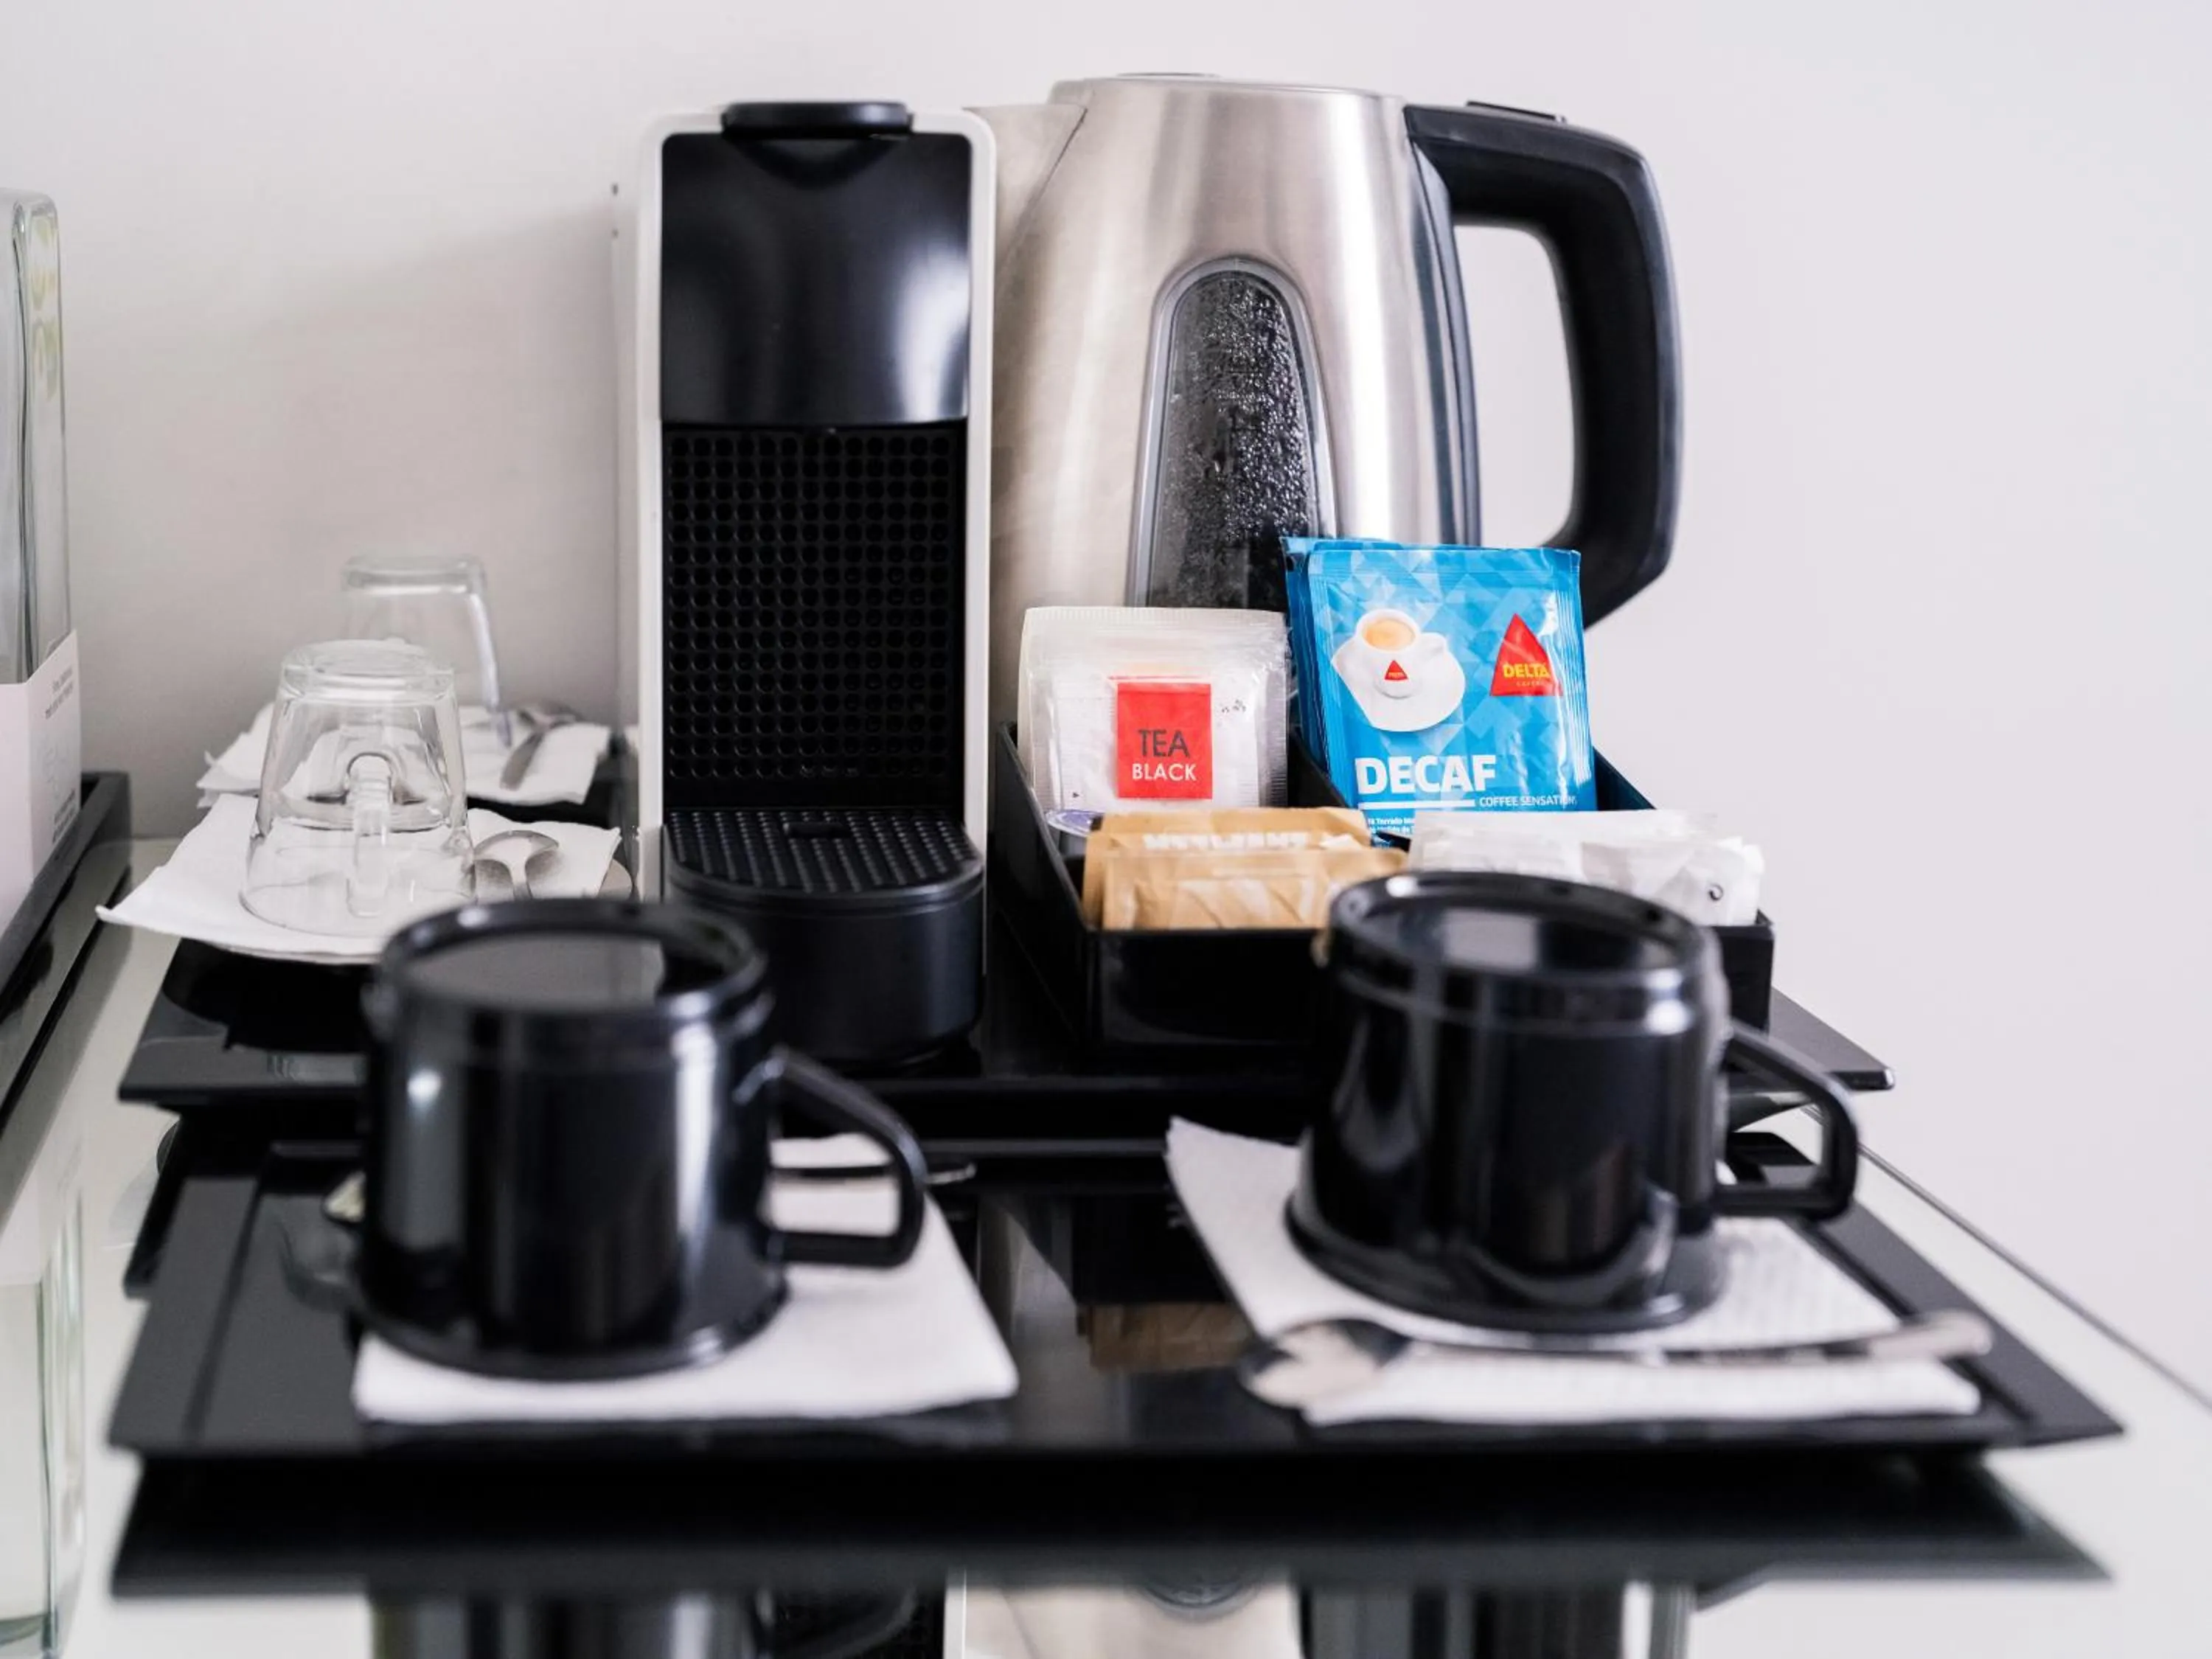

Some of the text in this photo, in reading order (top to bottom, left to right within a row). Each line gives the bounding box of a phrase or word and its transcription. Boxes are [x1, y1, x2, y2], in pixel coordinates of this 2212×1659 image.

[1503, 662, 1550, 678] DELTA
[1138, 728, 1191, 758] TEA
[1132, 762, 1197, 782] BLACK
[1354, 754, 1496, 794] DECAF
[1480, 796, 1518, 807] COFFEE
